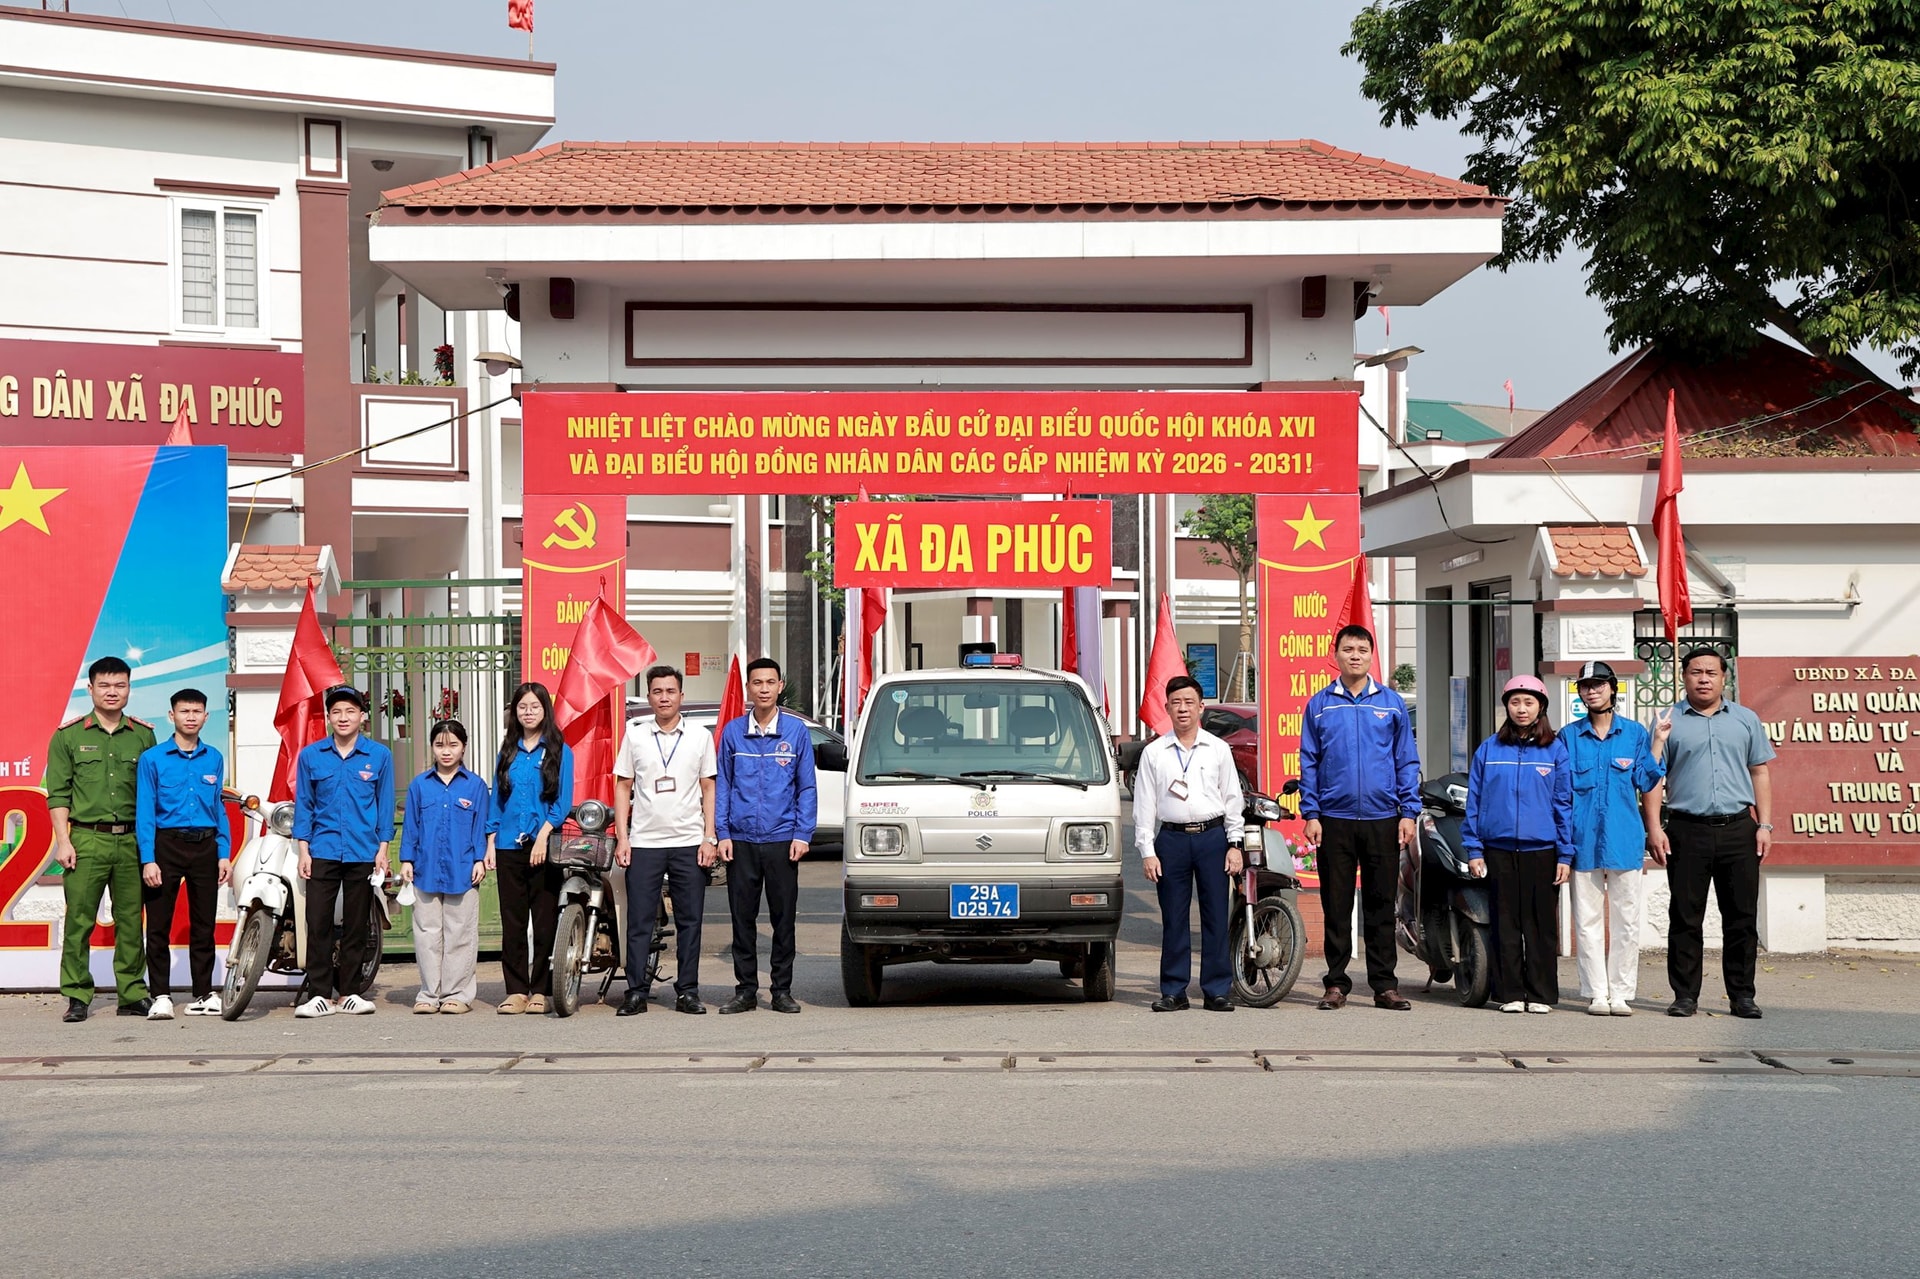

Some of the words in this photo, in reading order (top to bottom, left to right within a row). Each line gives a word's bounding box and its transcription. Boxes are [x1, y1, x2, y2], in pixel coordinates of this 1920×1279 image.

[33, 369, 93, 419] DÂN
[107, 373, 147, 421] XÃ
[160, 383, 198, 424] ĐA
[210, 377, 282, 427] PHÚC
[567, 412, 634, 443] NHIỆT
[640, 412, 687, 443] LIỆT
[693, 412, 755, 438] CHÀO
[762, 412, 830, 438] MỪNG
[837, 411, 899, 438] NGÀY
[905, 408, 951, 437] BẦU
[958, 408, 991, 437] CỬ
[994, 415, 1033, 442] ĐẠI
[1040, 406, 1092, 437] BIỂU
[1099, 407, 1160, 439] QUỐC
[1167, 411, 1204, 442] HỘI
[1211, 411, 1273, 438] KHÓA
[1279, 416, 1315, 438] XVI
[569, 448, 600, 475] VÀ
[605, 453, 644, 479] ĐẠI
[651, 444, 703, 475] BIỂU
[710, 448, 748, 479] HỘI
[754, 445, 818, 474] ĐỒNG
[825, 447, 889, 474] NHÂN
[896, 447, 943, 473] DÂN
[950, 447, 996, 474] CÁC
[1003, 444, 1048, 474] CẤP
[1055, 447, 1129, 478] NHIỆM
[1137, 447, 1166, 474] KỲ
[1172, 452, 1227, 474] 2026
[854, 513, 908, 572] XÃ
[920, 524, 974, 573] ĐA
[987, 513, 1093, 573] PHÚC
[1293, 590, 1328, 618] NƯỚC
[542, 642, 571, 676] CỘN
[1279, 629, 1314, 663] CỘNG
[1316, 628, 1333, 658] HÒ
[1290, 668, 1308, 697] XÃ
[1793, 667, 1849, 681] UBND
[1855, 663, 1884, 680] XÃ
[1890, 667, 1918, 680] ĐA
[1813, 692, 1859, 712] BAN
[1278, 705, 1303, 737] CHỦ
[1792, 717, 1823, 742] ÁN
[1829, 714, 1874, 742] ĐẦU
[1880, 720, 1910, 742] TƯ
[13, 755, 32, 777] TẾ
[1876, 746, 1905, 772] VÀ
[1829, 782, 1902, 803] TRUNG
[859, 806, 910, 815] CARRY
[1792, 812, 1844, 837] DỊCH
[1851, 812, 1881, 837] VỤ
[1888, 803, 1920, 833] TỔ
[970, 885, 999, 900] 29A
[957, 901, 1012, 917] 029.74
